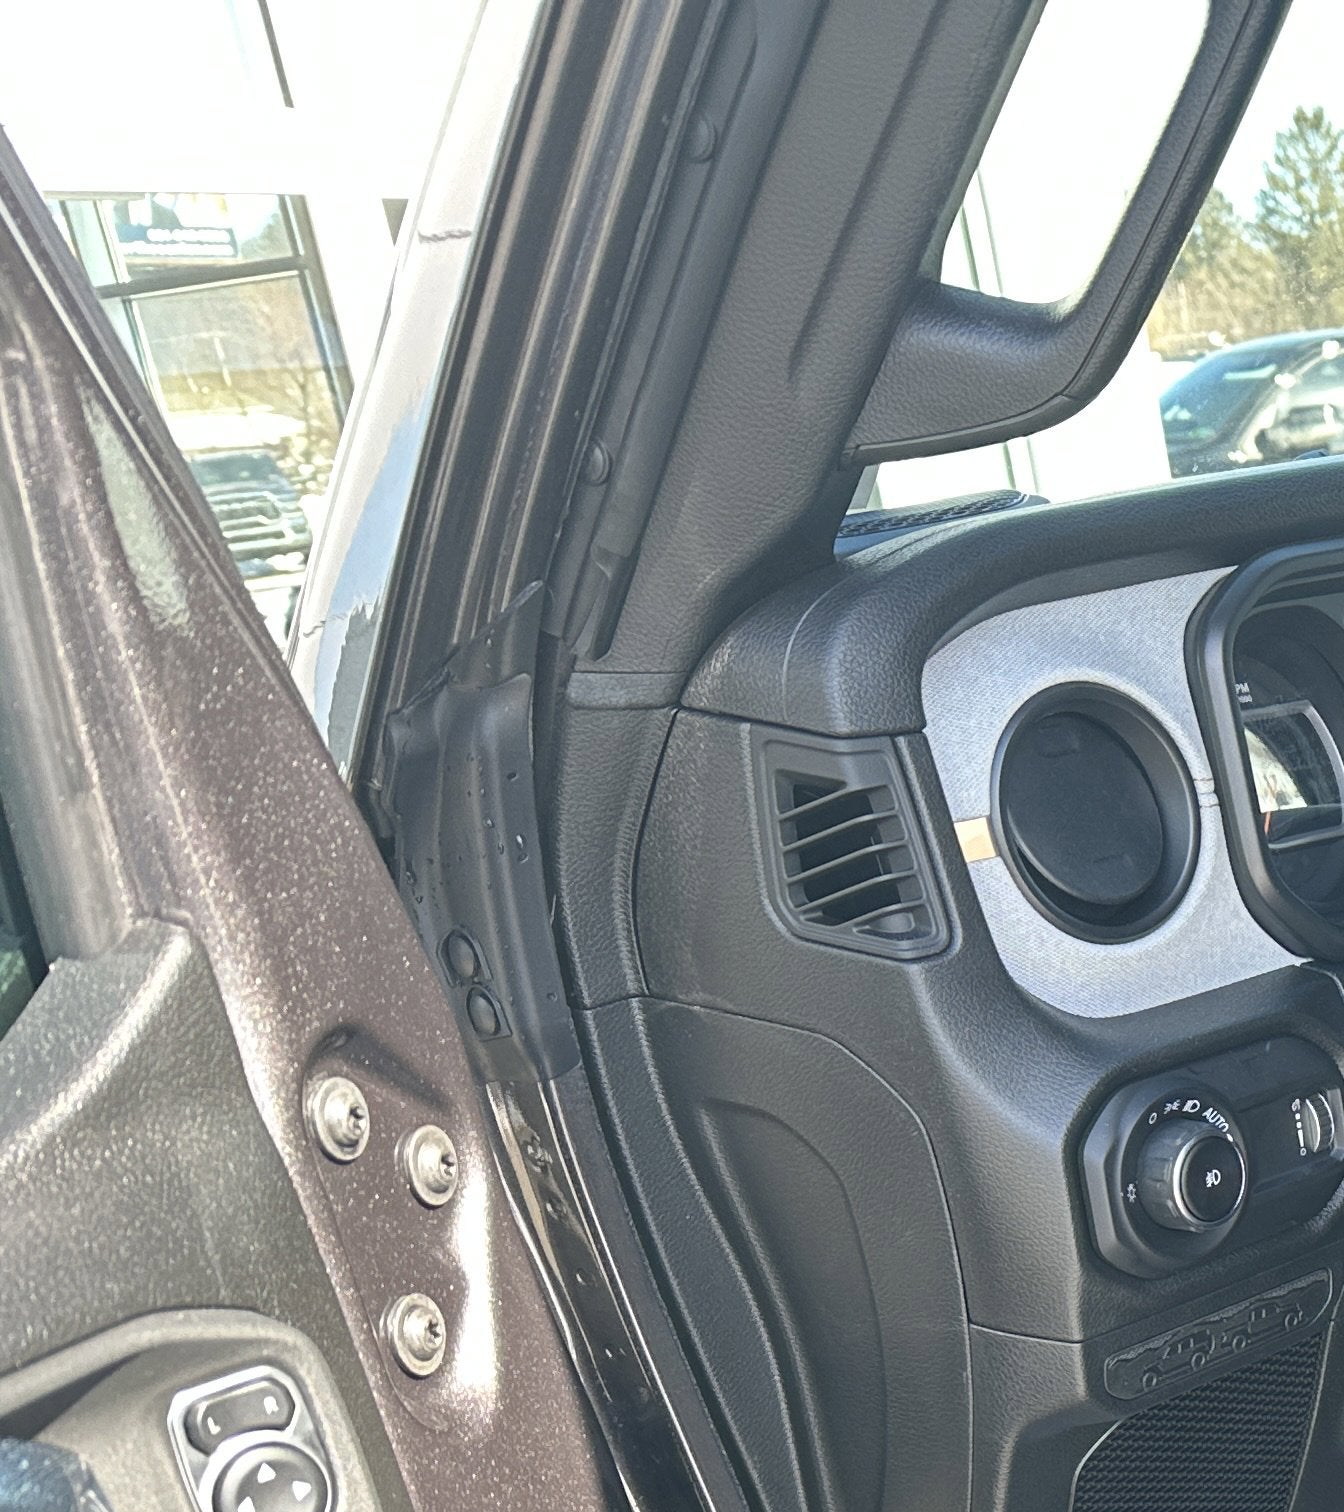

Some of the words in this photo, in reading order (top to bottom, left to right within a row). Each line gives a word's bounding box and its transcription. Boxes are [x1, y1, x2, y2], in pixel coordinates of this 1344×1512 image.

[1202, 1107, 1230, 1133] AUTO
[263, 1396, 279, 1415] R
[207, 1416, 221, 1435] L
